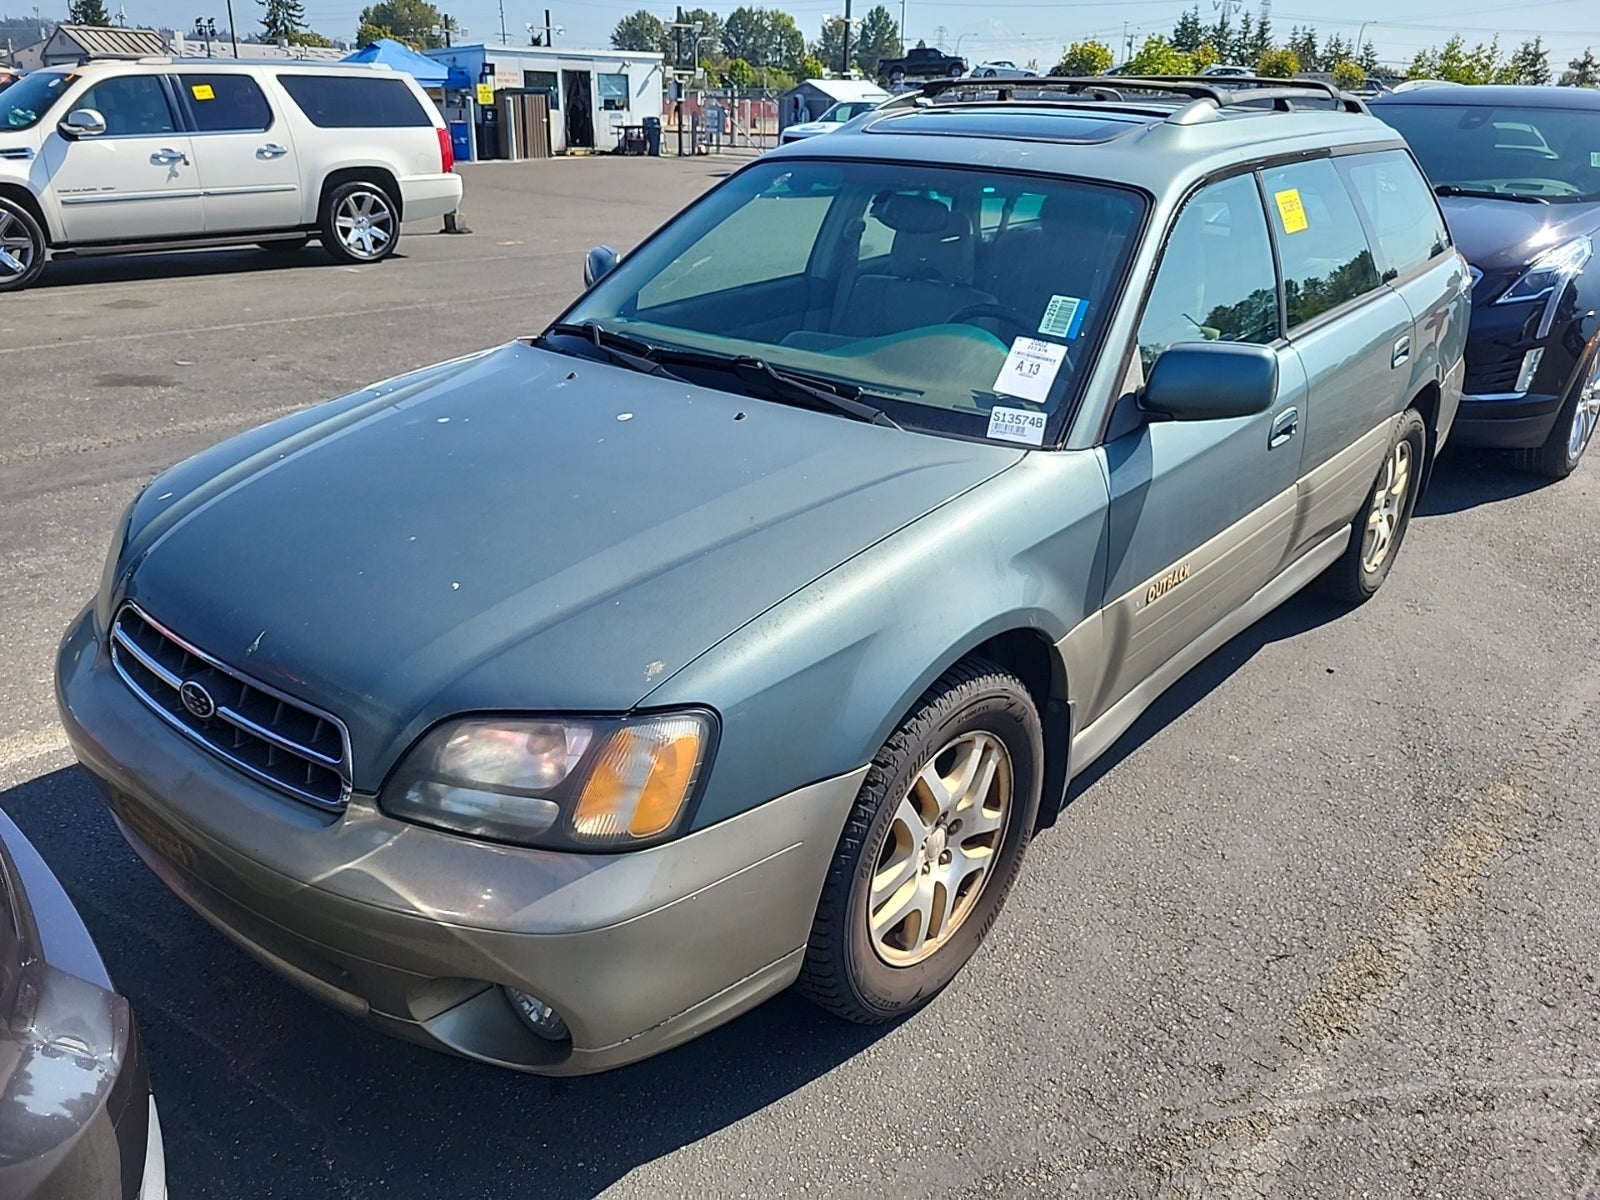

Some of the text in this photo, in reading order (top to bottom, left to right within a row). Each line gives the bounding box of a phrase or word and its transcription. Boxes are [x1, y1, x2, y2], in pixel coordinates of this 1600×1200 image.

[1015, 360, 1041, 375] A 13
[993, 412, 1044, 428] S13574B
[1146, 563, 1191, 605] OUTBACK
